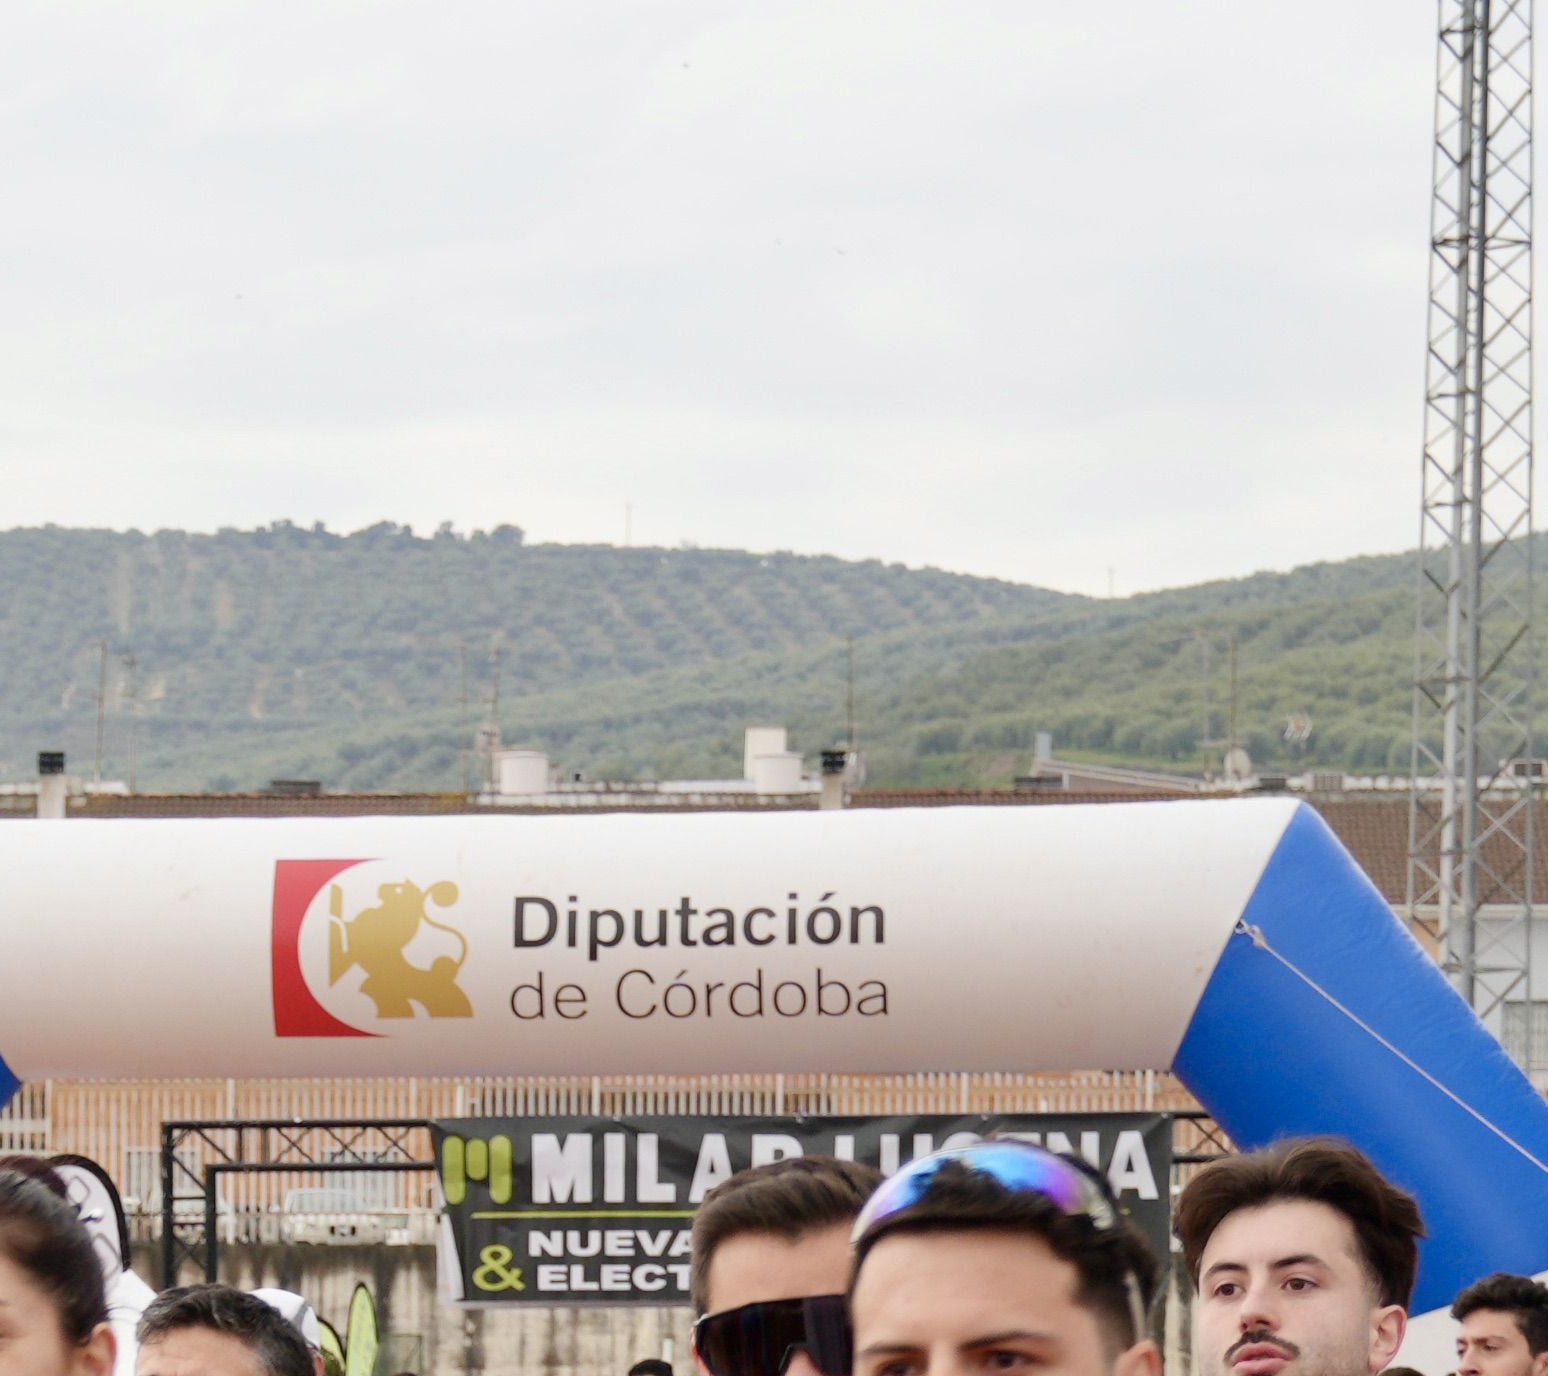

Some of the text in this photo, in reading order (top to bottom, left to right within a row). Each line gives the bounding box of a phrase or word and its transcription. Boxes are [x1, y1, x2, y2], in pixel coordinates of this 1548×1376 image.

[512, 892, 887, 962] Diputación
[510, 968, 889, 1021] de Córdoba
[473, 1244, 526, 1293] &
